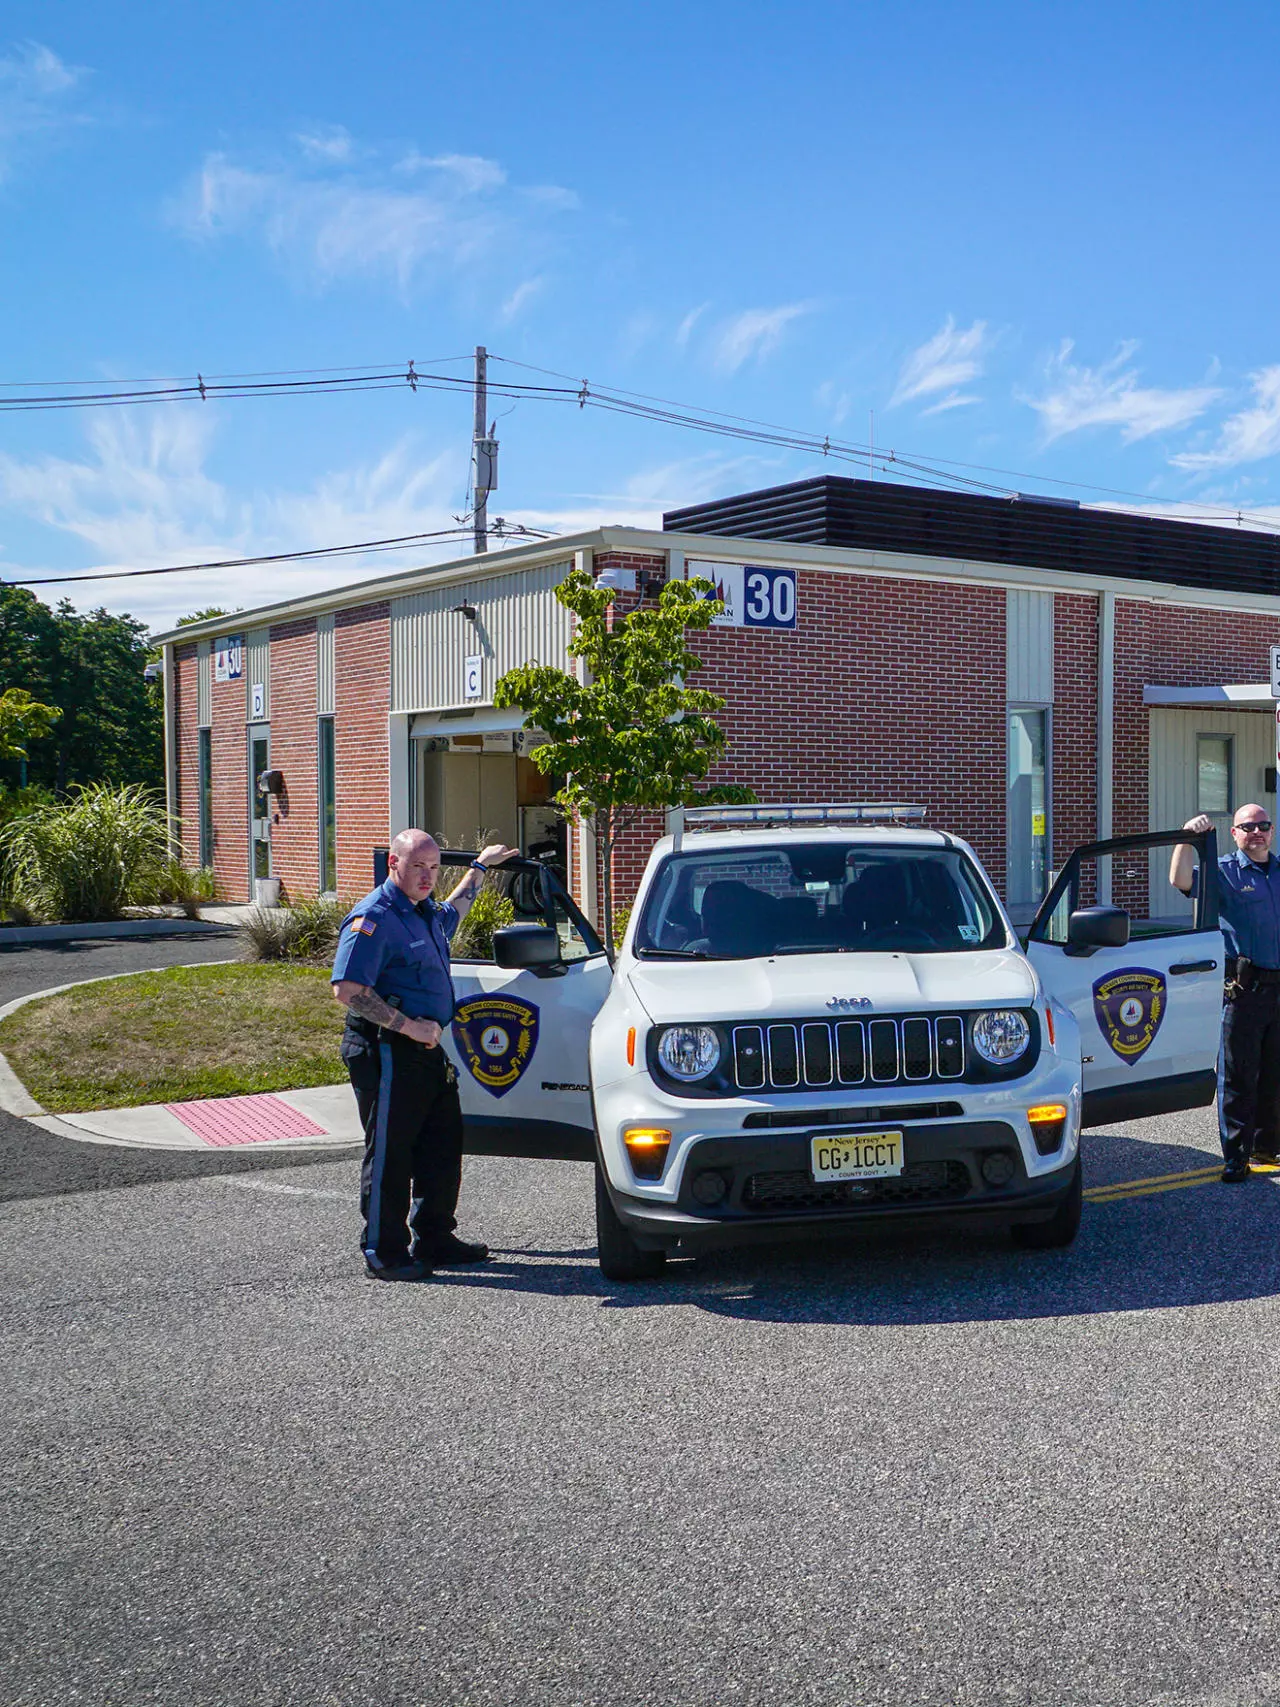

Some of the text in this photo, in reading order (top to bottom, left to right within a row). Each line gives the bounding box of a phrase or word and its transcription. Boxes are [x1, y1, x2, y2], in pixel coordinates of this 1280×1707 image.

[746, 573, 795, 623] 30
[468, 670, 477, 692] C
[255, 695, 262, 712] D
[825, 996, 873, 1009] Jeep
[834, 1136, 881, 1146] New Jersey
